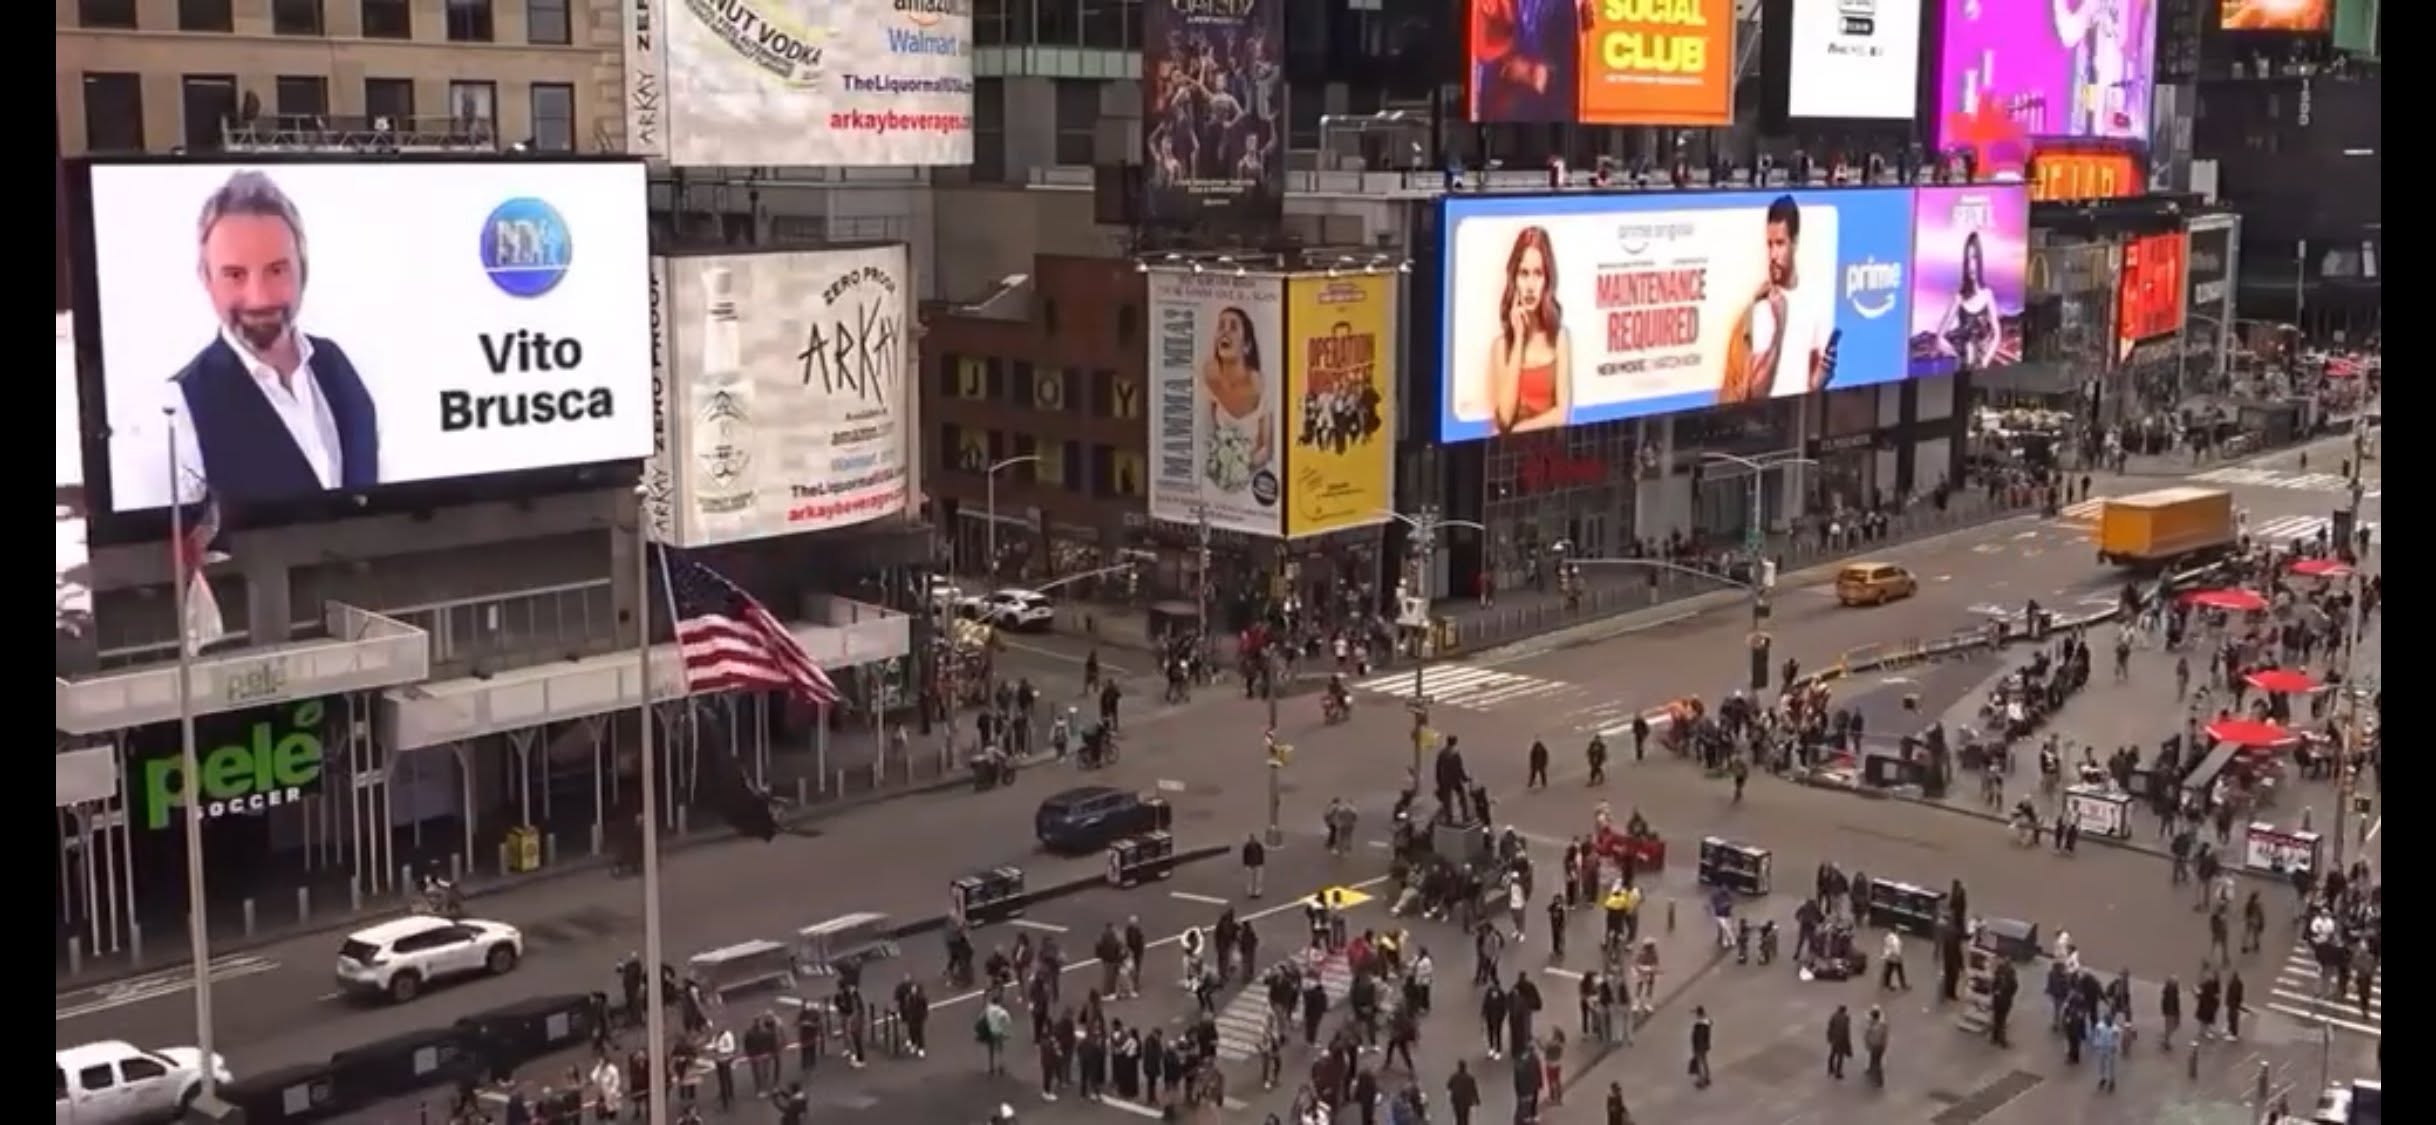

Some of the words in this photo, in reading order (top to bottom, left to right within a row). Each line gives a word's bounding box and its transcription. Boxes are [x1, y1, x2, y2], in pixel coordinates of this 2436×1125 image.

[1605, 0, 1707, 26] SOCIAL
[758, 22, 824, 66] VODKA
[1603, 31, 1707, 73] CLUB
[822, 269, 860, 306] ZERO
[1596, 268, 1707, 309] MAINTENANCE
[1846, 256, 1901, 297] prime
[478, 327, 583, 375] Vito
[798, 296, 902, 404] ARKAY
[1607, 306, 1699, 353] REQUIRED
[440, 385, 615, 433] Brusca
[1162, 377, 1195, 480] MAMMA
